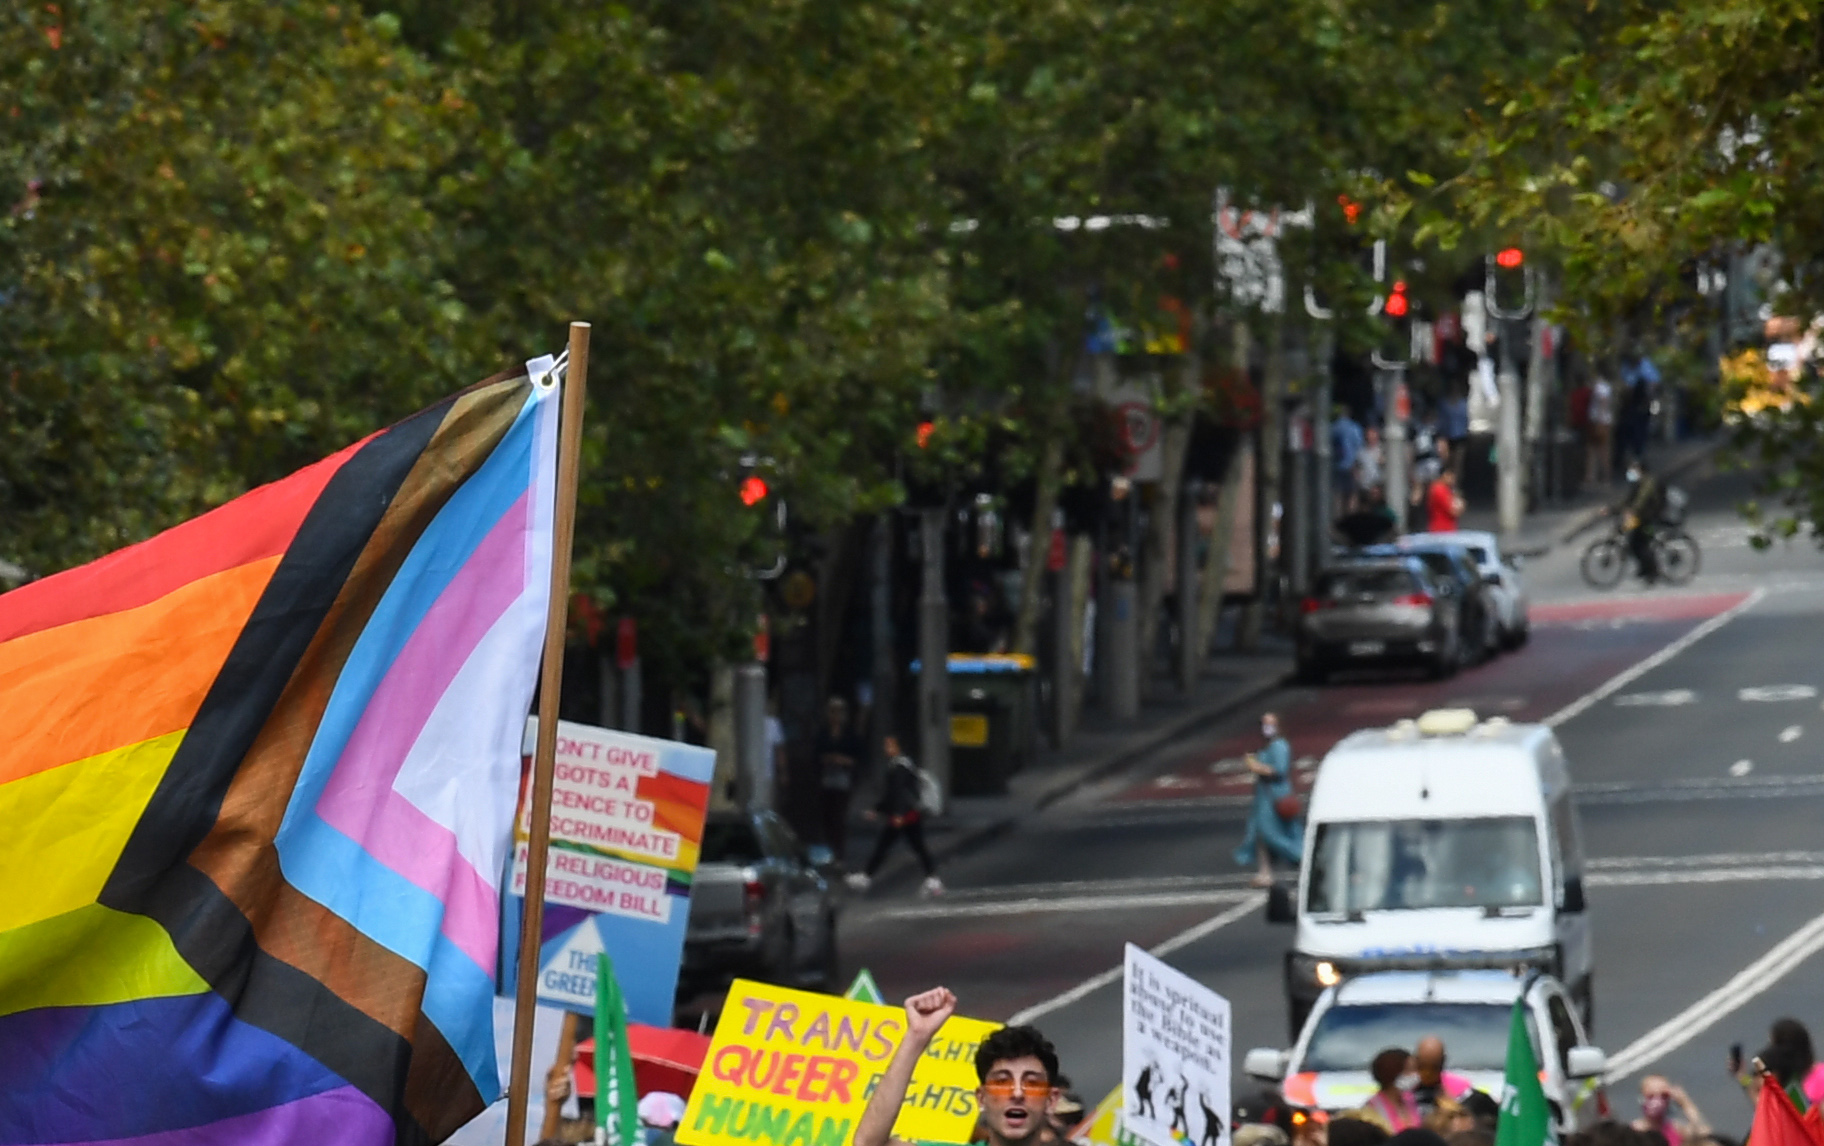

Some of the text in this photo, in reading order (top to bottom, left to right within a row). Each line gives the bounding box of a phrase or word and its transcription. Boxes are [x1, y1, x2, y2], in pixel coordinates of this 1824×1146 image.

[555, 737, 656, 773] ON'T GIVE
[554, 763, 631, 792] GOTS A
[551, 789, 651, 823] CENCE TO
[554, 853, 665, 891] RELIGIOUS
[515, 872, 663, 917] FEEDOM BILL
[544, 971, 597, 998] GREEN
[741, 997, 900, 1061] TRANS
[712, 1044, 859, 1104] QUEER
